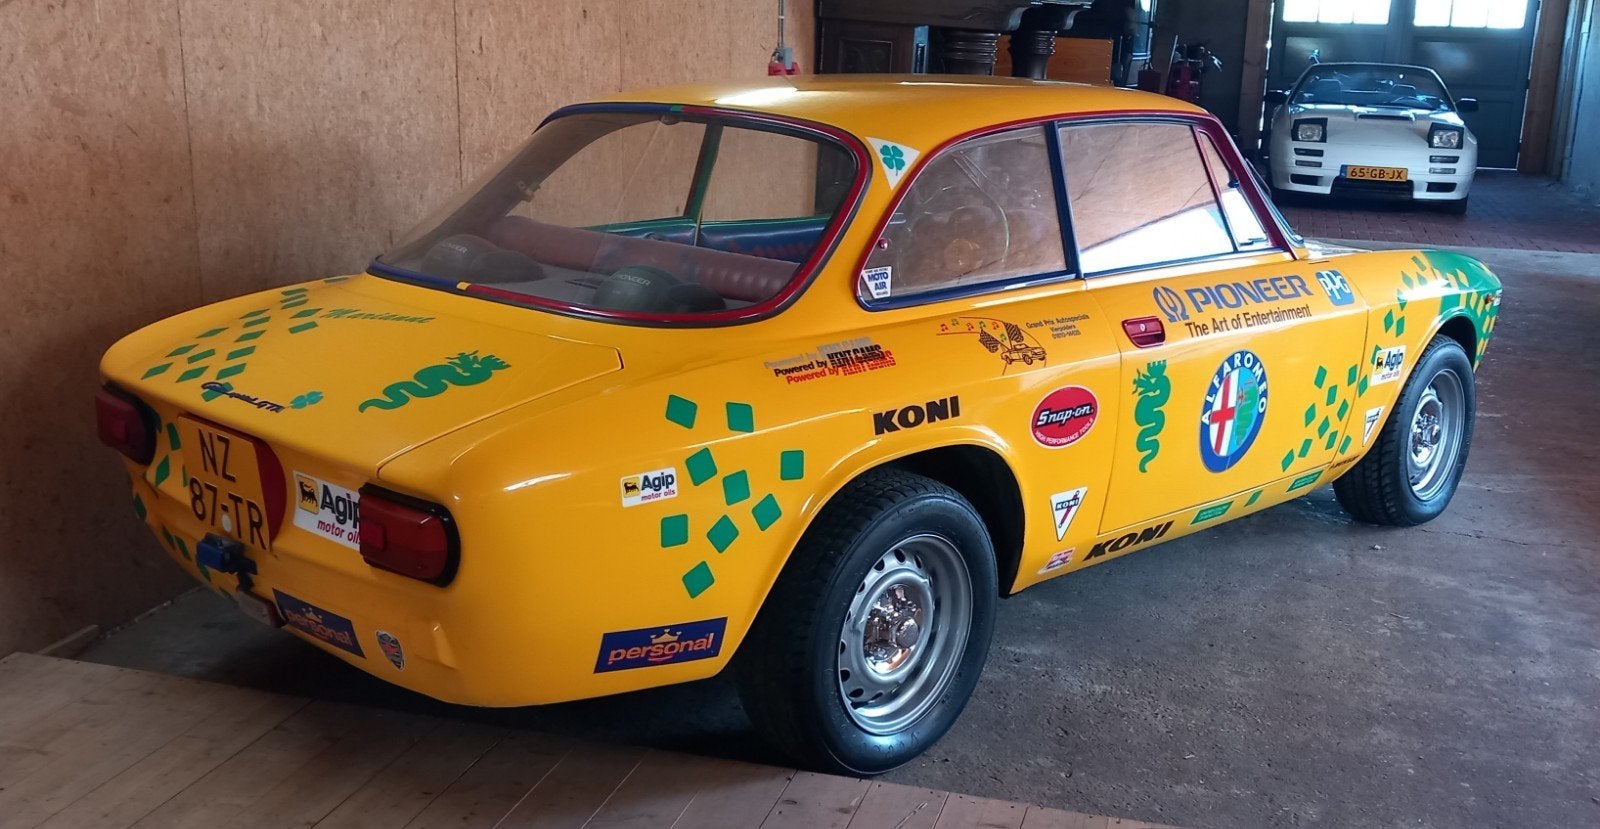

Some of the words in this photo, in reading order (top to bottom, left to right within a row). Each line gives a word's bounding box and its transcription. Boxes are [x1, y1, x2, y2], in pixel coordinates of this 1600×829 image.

[1351, 168, 1403, 180] 65-GB-JX
[867, 271, 889, 282] MOTO
[874, 281, 888, 291] AIR
[1184, 274, 1314, 314] PIONEER
[1185, 321, 1210, 338] The
[1211, 317, 1230, 334] Art
[1232, 313, 1243, 329] of
[1244, 303, 1313, 327] Entertainment
[773, 361, 815, 377] Powered
[815, 359, 828, 369] by
[1384, 348, 1404, 371] Agip
[786, 370, 827, 385] Powered
[827, 366, 840, 377] by
[873, 395, 960, 436] KONI
[1036, 404, 1092, 426] Snap-on
[1046, 431, 1080, 445] PERFORMANCE
[198, 428, 237, 483] NZ
[641, 471, 675, 492] Agip
[641, 492, 662, 501] motor
[663, 488, 676, 497] oils
[1056, 498, 1079, 510] KONI
[189, 475, 267, 551] 87-TR
[316, 519, 346, 538] motor
[347, 530, 360, 544] oil
[1081, 519, 1175, 562] KONI
[606, 631, 715, 666] personal
